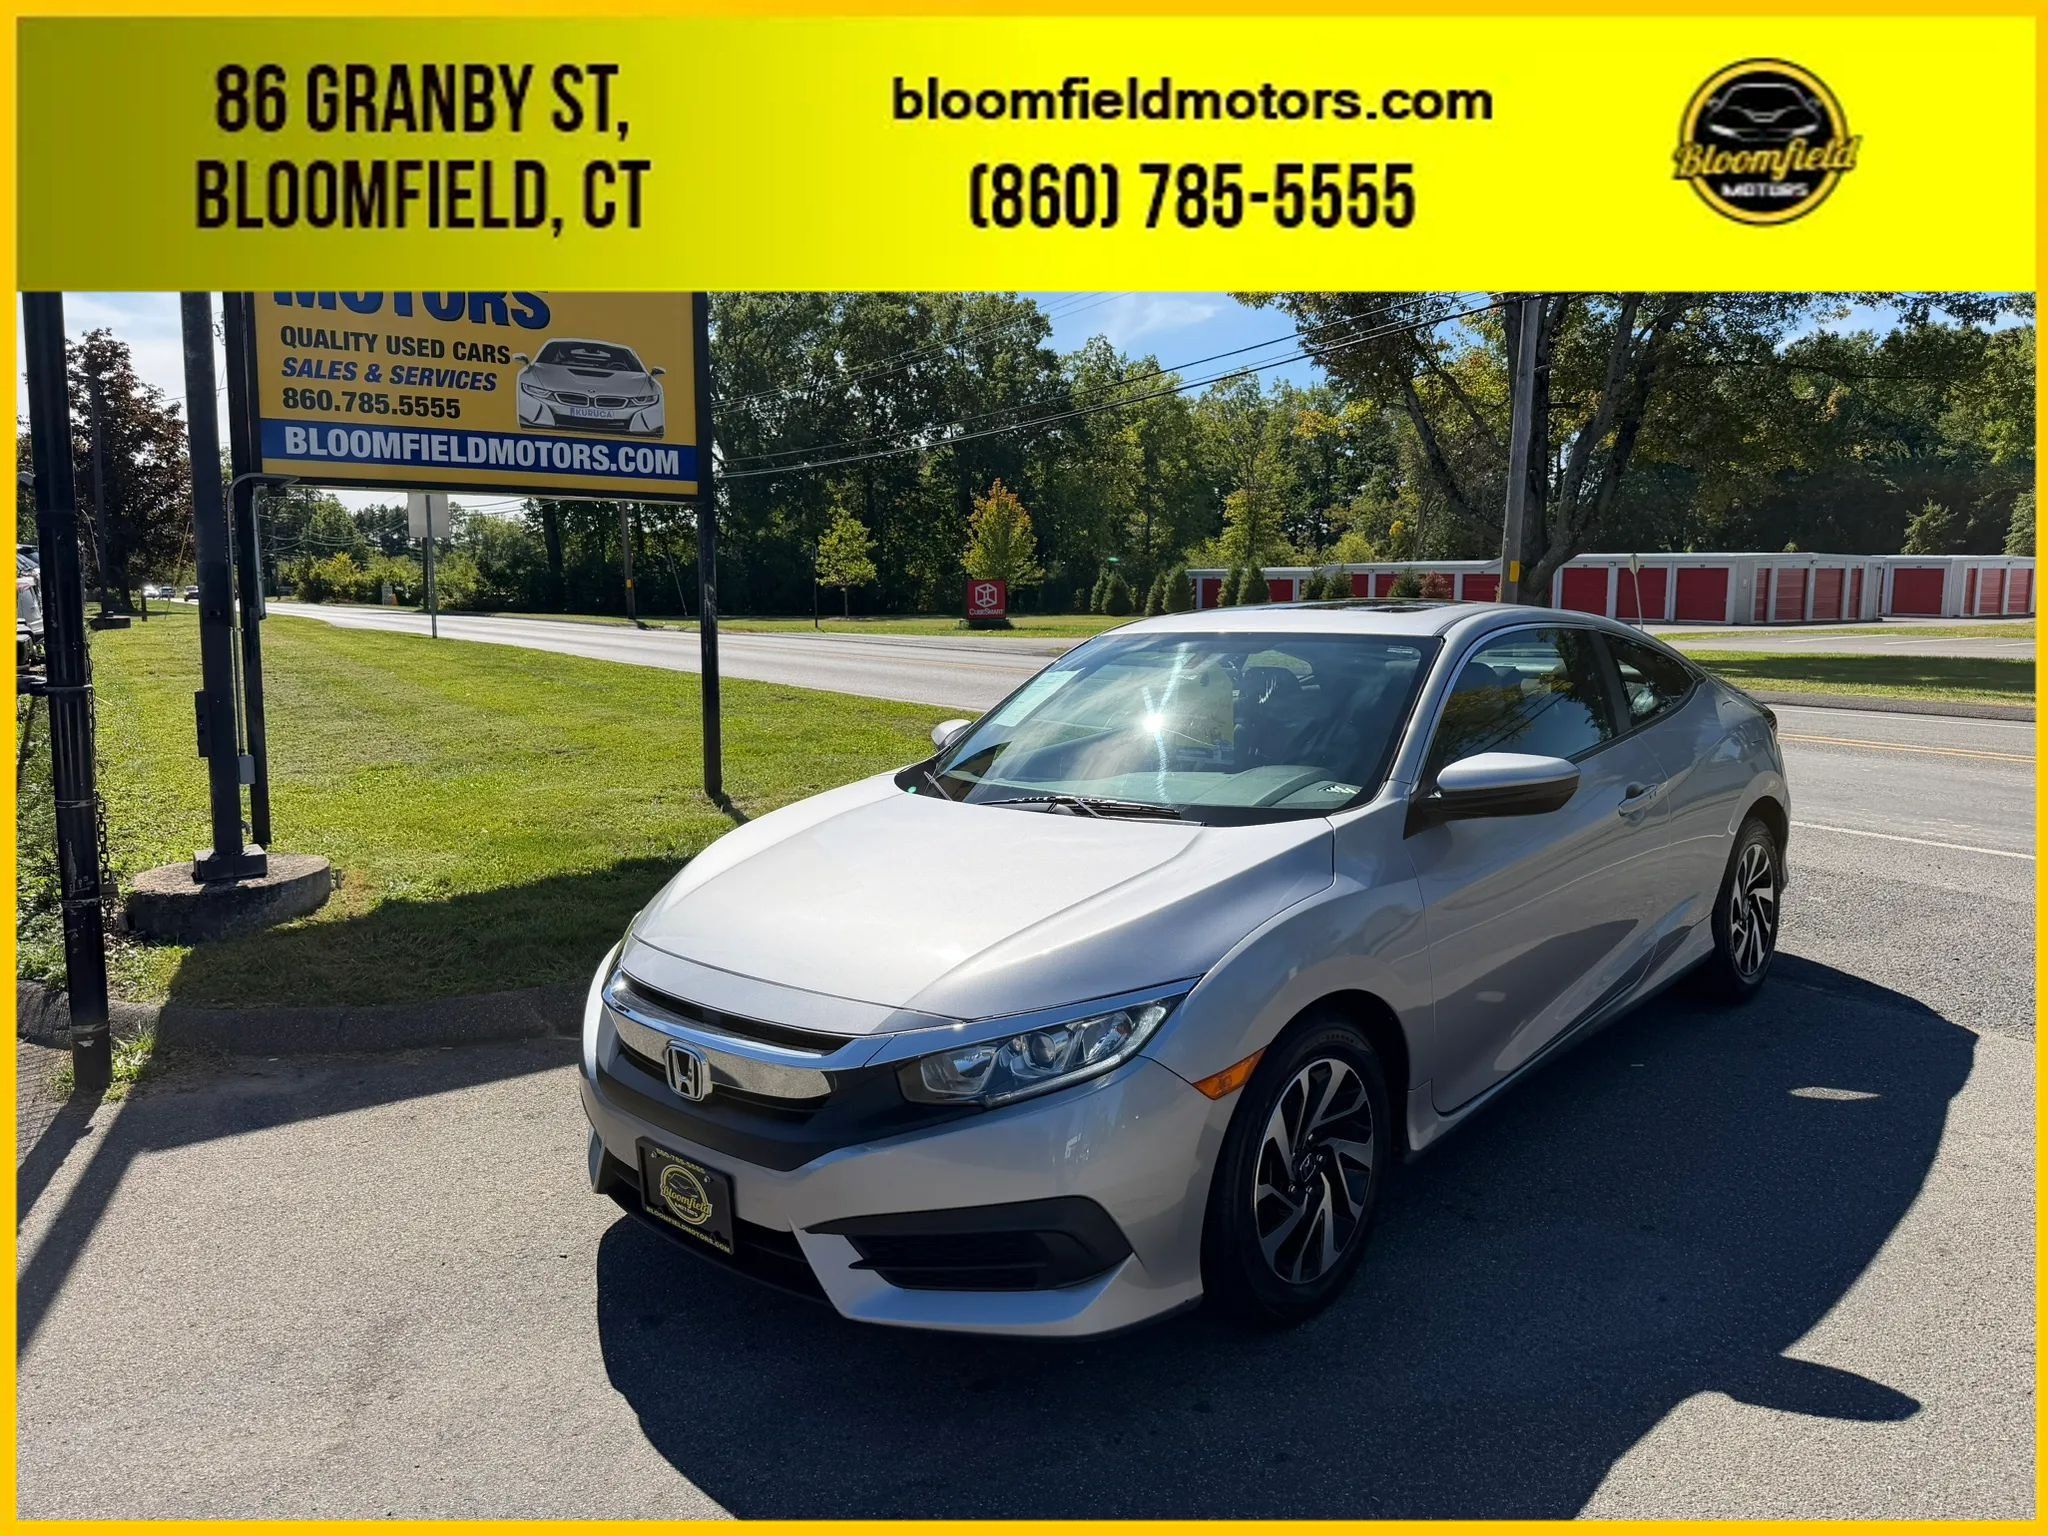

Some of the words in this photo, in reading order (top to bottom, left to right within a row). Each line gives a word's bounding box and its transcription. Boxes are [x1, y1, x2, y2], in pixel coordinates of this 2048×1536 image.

[273, 290, 551, 330] ORS
[280, 325, 378, 353] QUALITY
[385, 335, 445, 359] USED
[452, 341, 511, 365] CARS
[281, 357, 359, 381] SALES
[364, 363, 382, 383] &
[389, 364, 498, 392] SERVICES
[281, 387, 461, 419] 860.785.5555
[284, 425, 680, 475] BLOOMFIELDMOTORS.COM
[661, 1185, 711, 1215] Bloomfield
